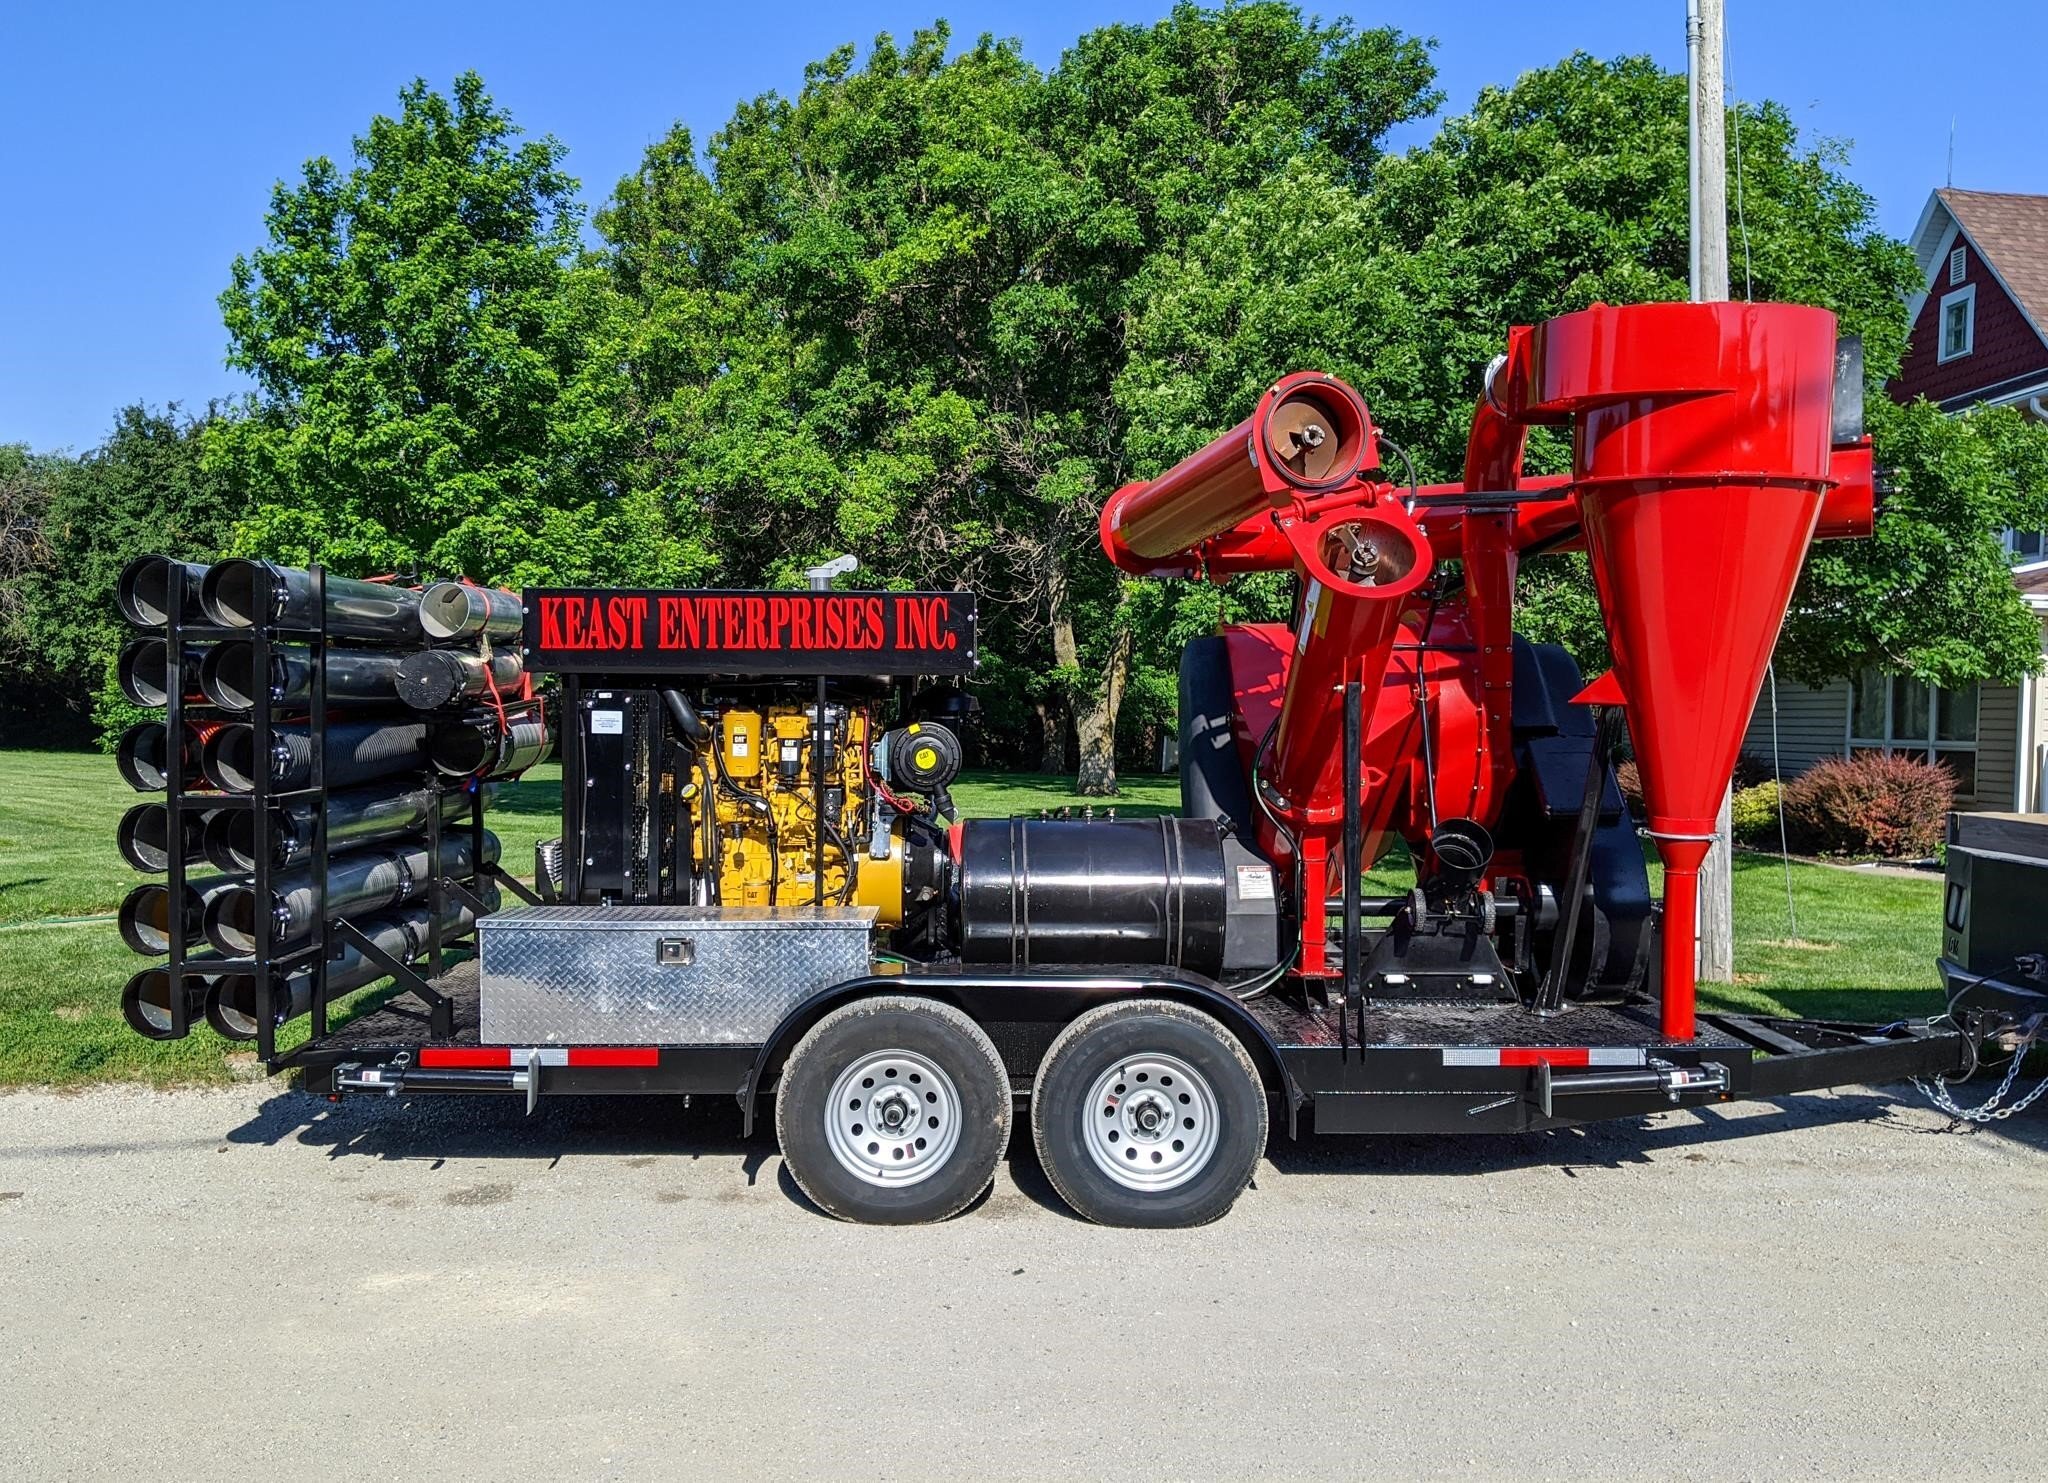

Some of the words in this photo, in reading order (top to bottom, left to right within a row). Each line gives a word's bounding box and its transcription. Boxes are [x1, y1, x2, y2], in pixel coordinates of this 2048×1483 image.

[539, 597, 648, 649] KEAST
[658, 597, 884, 649] ENTERPRISES
[895, 597, 956, 649] INC.
[734, 735, 746, 743] CAT
